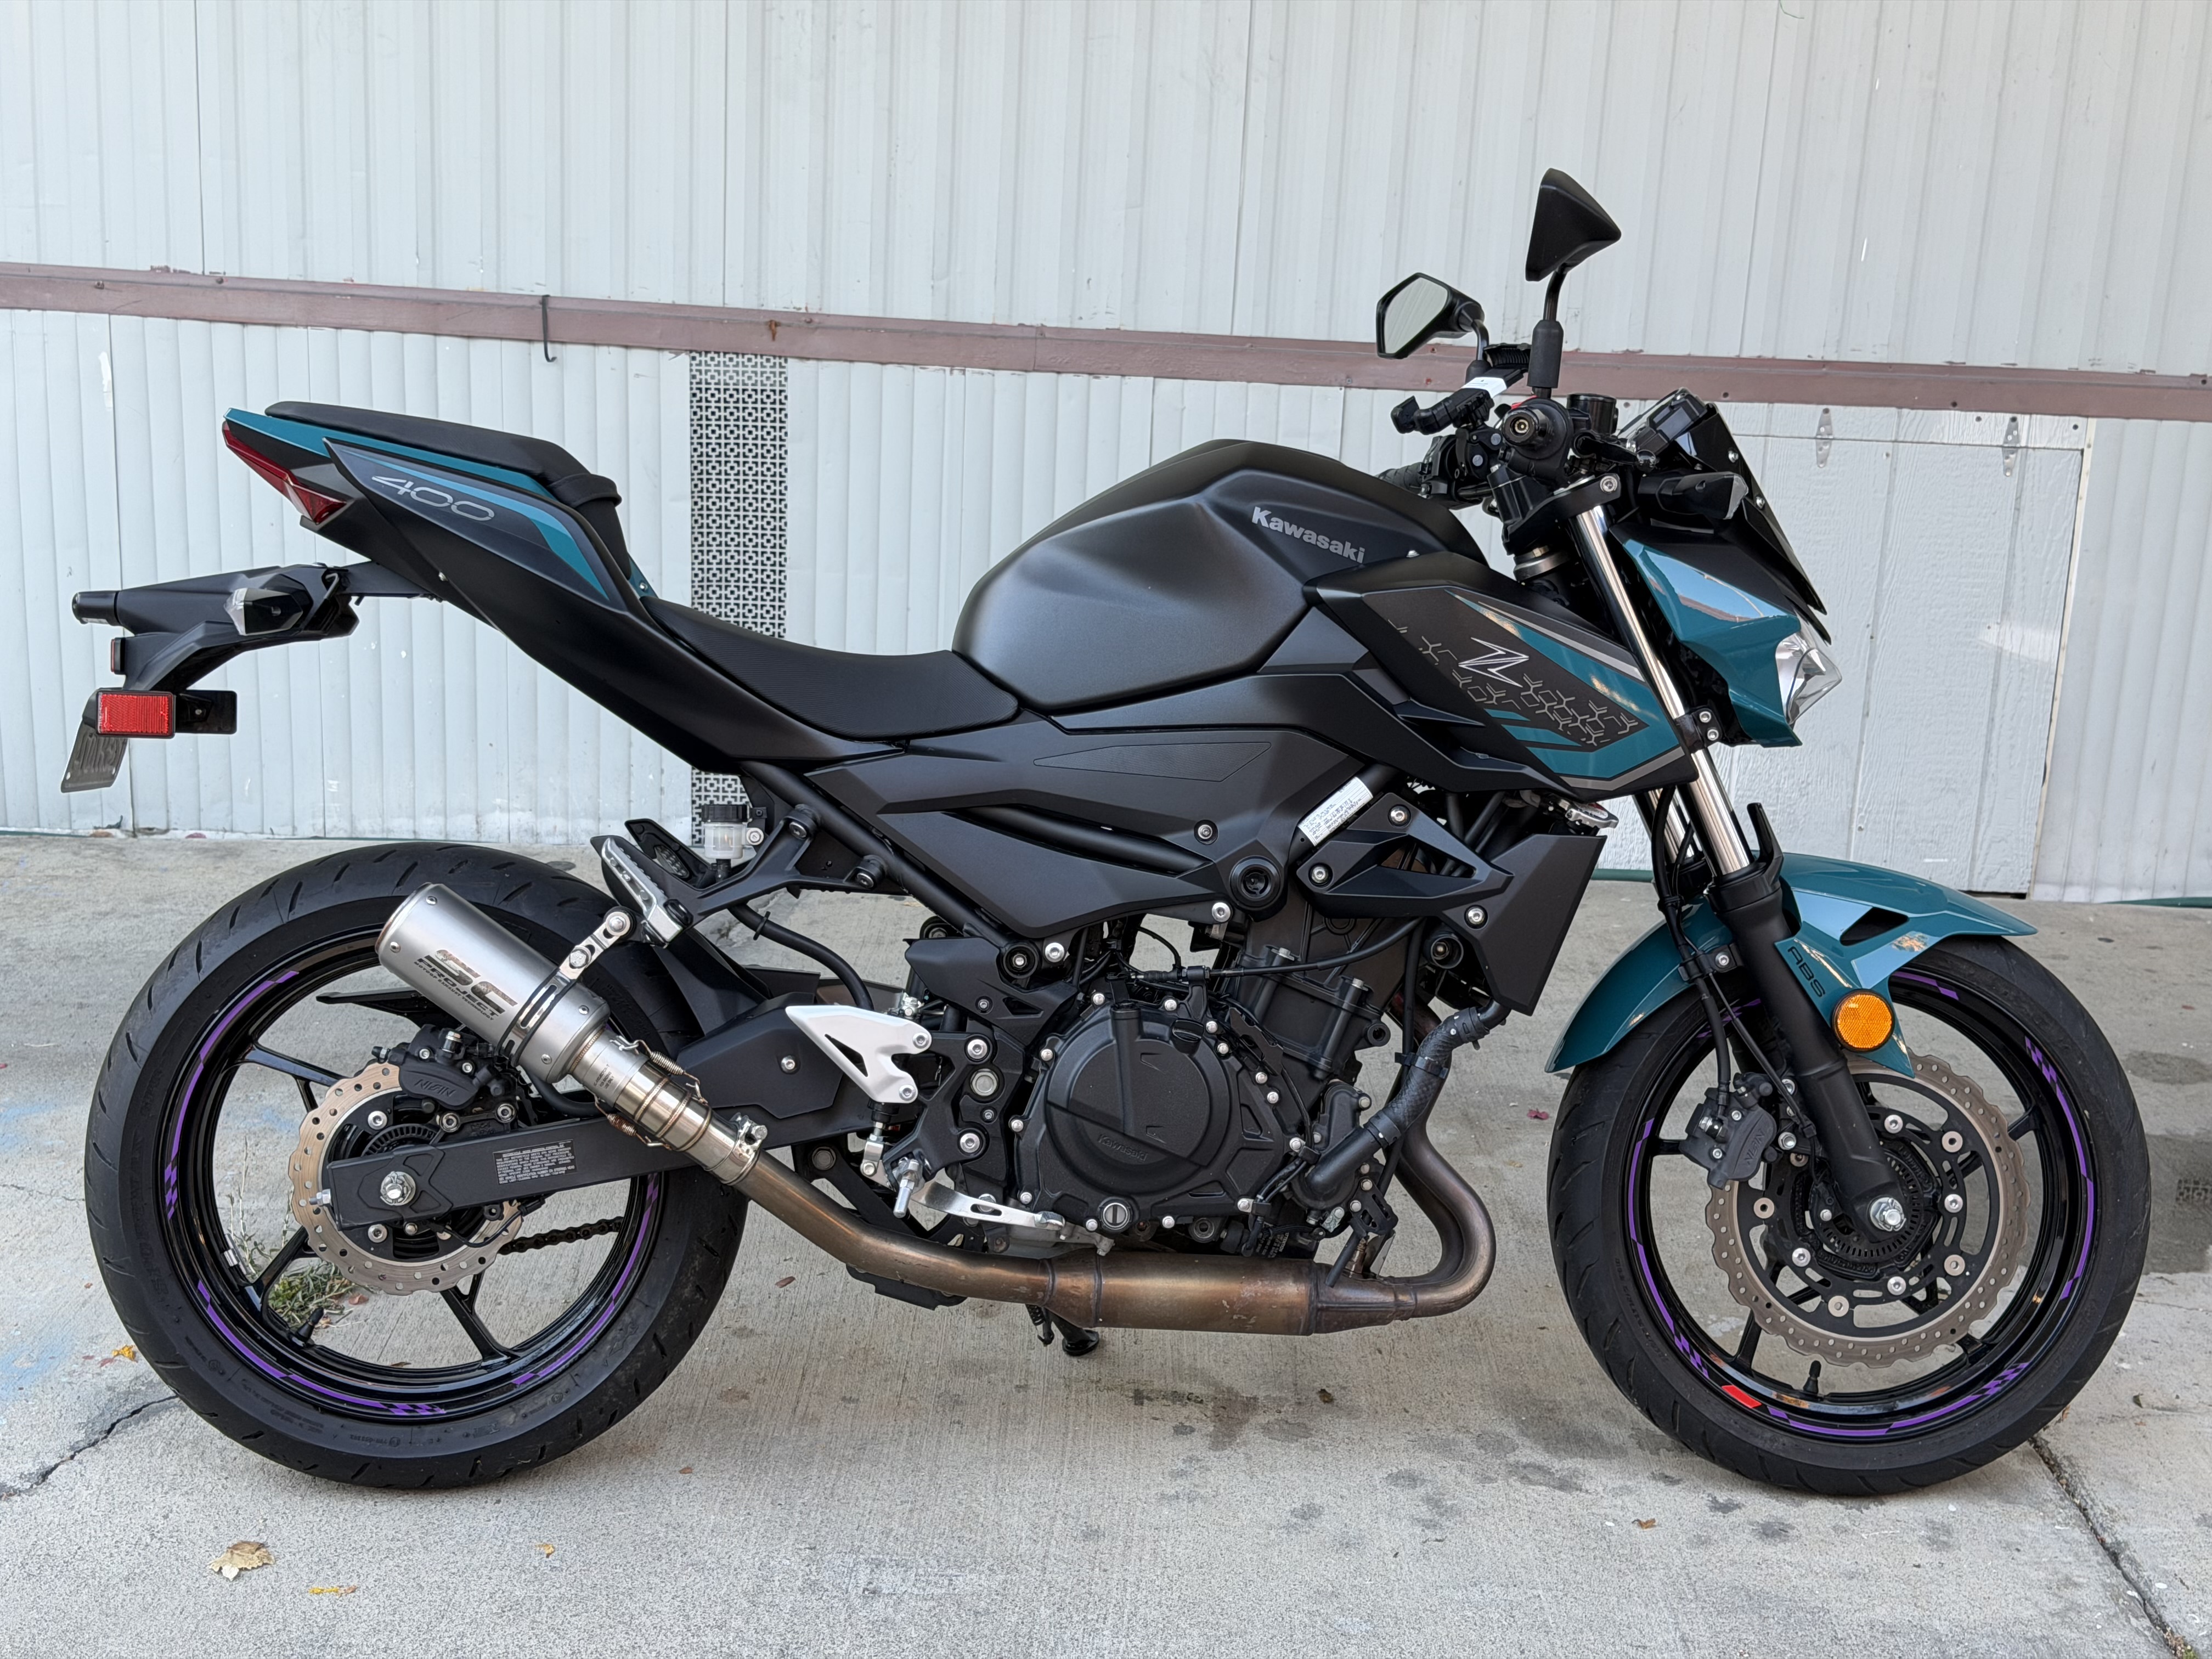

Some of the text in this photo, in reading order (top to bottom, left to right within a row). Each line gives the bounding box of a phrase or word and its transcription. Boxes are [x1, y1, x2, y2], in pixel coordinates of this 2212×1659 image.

[371, 475, 495, 521] 400
[1251, 507, 1366, 564] Kawasaki
[416, 958, 499, 1017] PROJECT
[424, 950, 518, 1014] SC
[1787, 946, 1826, 998] ABS
[438, 979, 461, 997] EXHAUST
[461, 996, 494, 1020] TECHNOLOGY
[1098, 1134, 1148, 1161] Kawasaki
